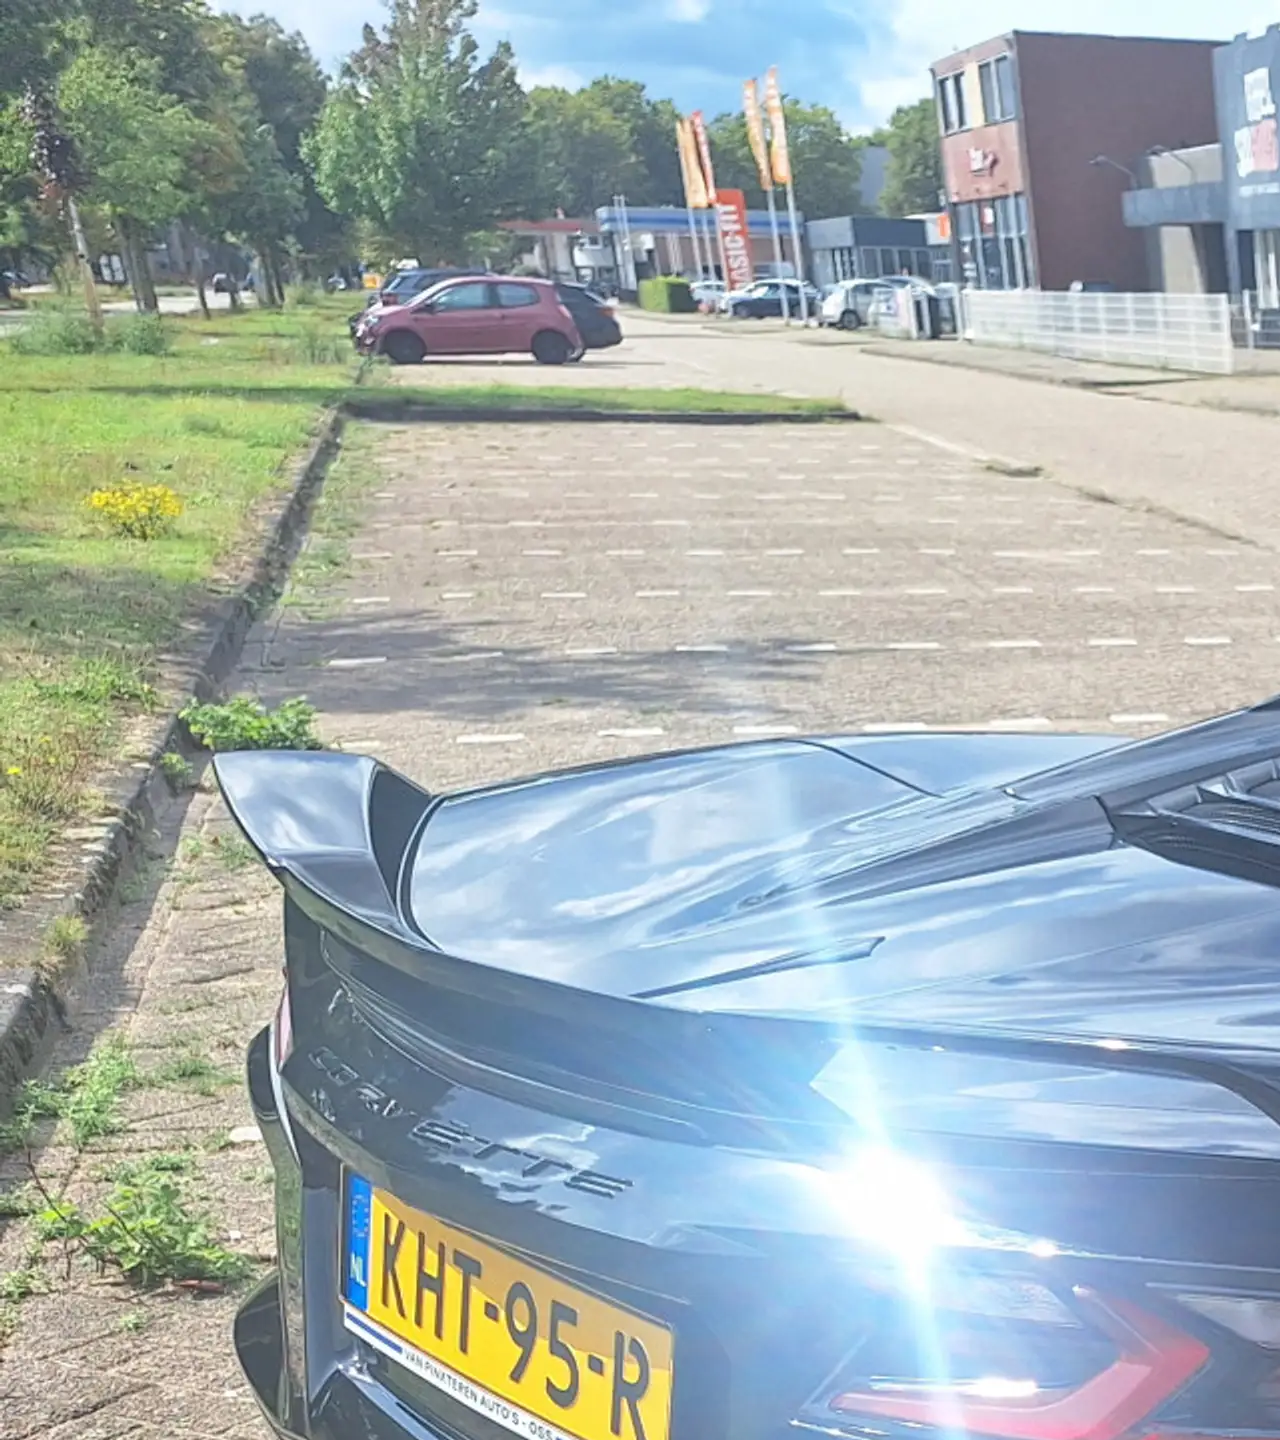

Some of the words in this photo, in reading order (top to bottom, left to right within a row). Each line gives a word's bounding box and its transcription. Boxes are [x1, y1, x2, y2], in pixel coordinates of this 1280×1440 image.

[349, 1252, 368, 1287] NL
[404, 1349, 423, 1369] VAN
[479, 1396, 519, 1425] AUTO'S
